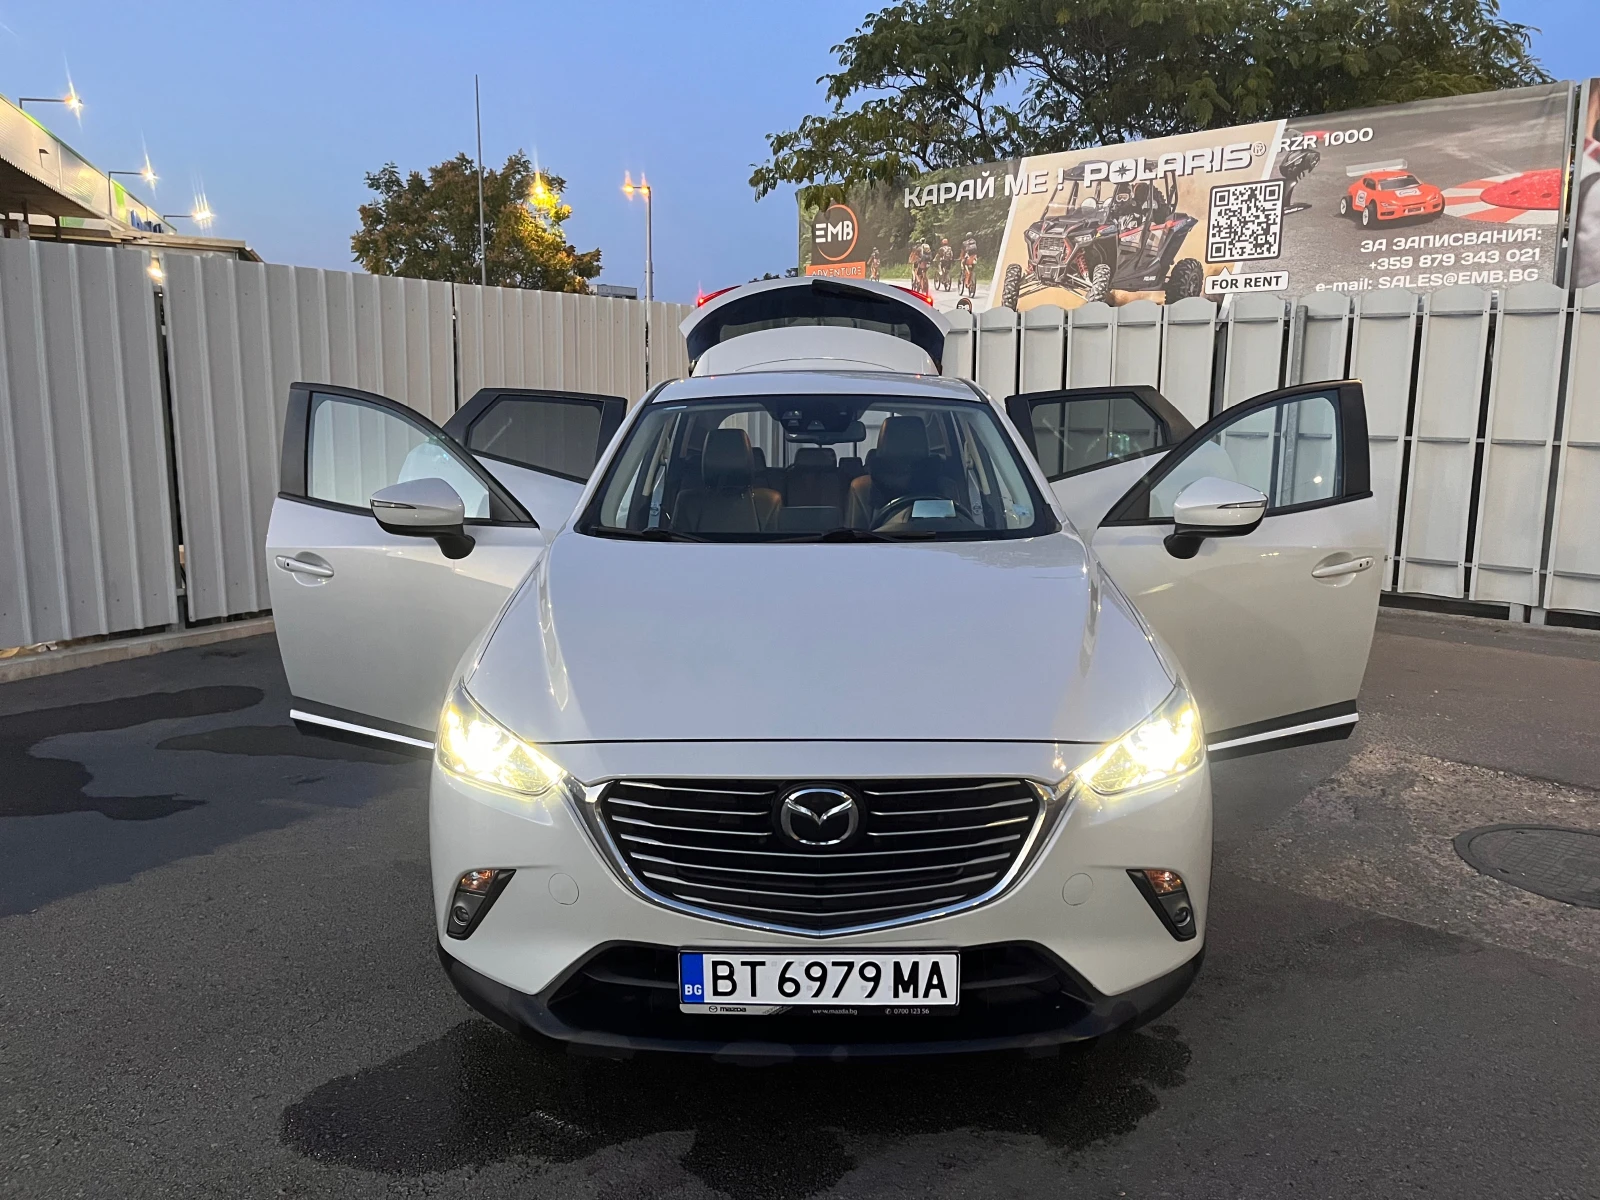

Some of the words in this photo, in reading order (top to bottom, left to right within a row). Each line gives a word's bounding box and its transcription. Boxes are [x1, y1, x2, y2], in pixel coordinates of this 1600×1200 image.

[1279, 135, 1317, 152] RZR
[1323, 127, 1374, 147] 1000
[904, 171, 995, 208] КАРАЙ
[815, 220, 854, 243] EMB
[1360, 239, 1386, 253] ЗА
[1392, 227, 1542, 250] ЗАПИСВАНИЯ:
[812, 266, 862, 278] ADVENTURE
[1369, 256, 1413, 271] +359
[1419, 253, 1455, 268] 879
[1461, 250, 1500, 265] 343
[1505, 248, 1541, 262] 021
[1211, 278, 1239, 290] FOR
[1243, 275, 1282, 288] RENT
[1315, 277, 1373, 293] e-mail:
[1378, 268, 1539, 290] SALES@EMB.BG
[684, 984, 703, 996] BG
[711, 960, 766, 997] BT
[777, 960, 882, 999] 6979
[892, 960, 948, 999] MA
